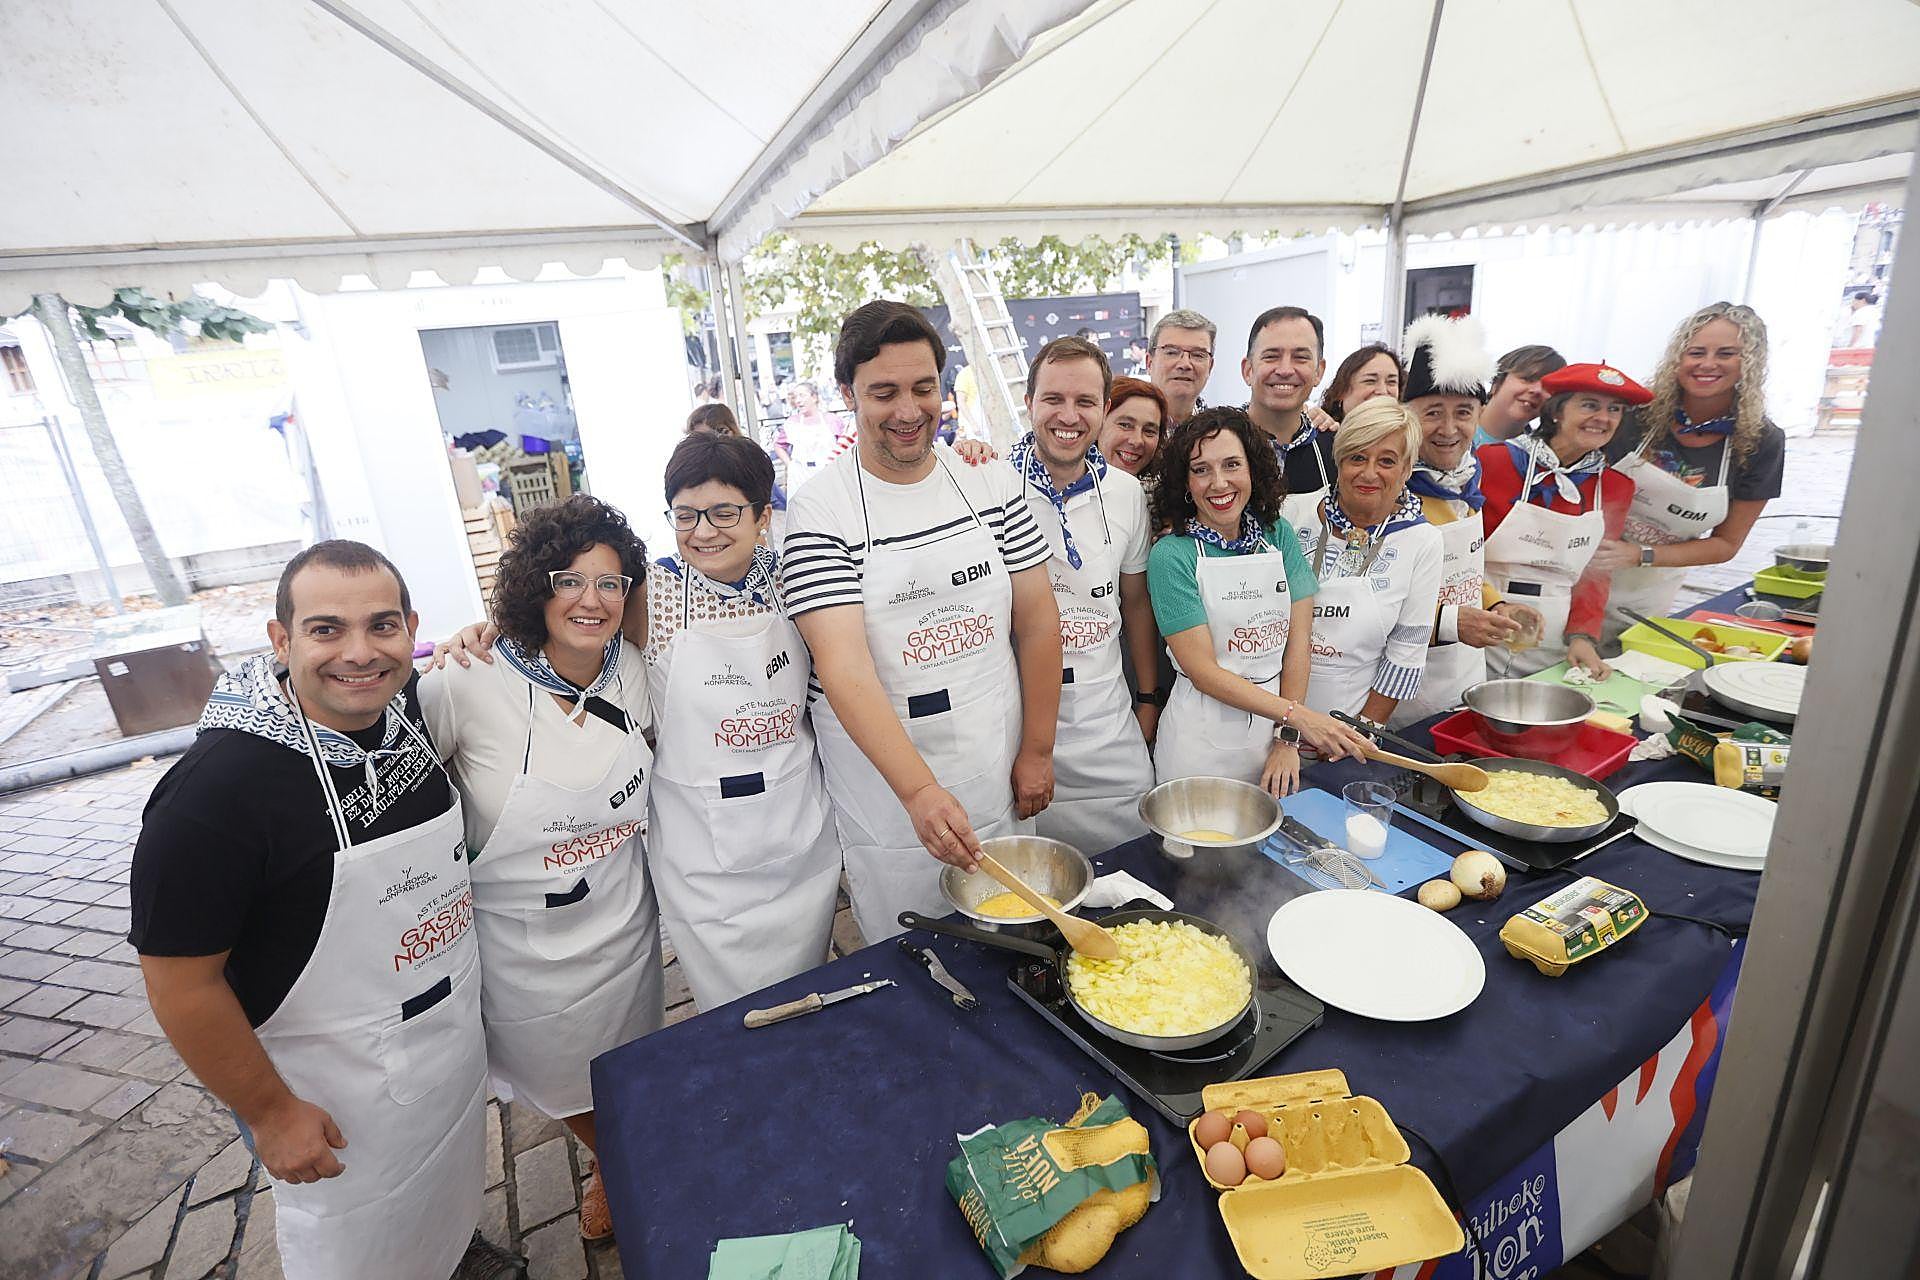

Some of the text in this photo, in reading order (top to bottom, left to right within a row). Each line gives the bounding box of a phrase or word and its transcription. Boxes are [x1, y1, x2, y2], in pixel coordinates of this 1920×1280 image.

[1680, 510, 1708, 521] BM
[1573, 536, 1590, 548] BM
[967, 561, 992, 582] BM
[918, 604, 975, 626] ASTE NAGUSIA
[1076, 607, 1109, 619] NAGUSIA
[1323, 605, 1351, 618] BM
[907, 614, 994, 648] GASTRO-
[902, 626, 995, 666] NOMIKOA
[771, 650, 790, 675] BM
[735, 701, 757, 715] ASTE
[626, 767, 644, 798] BM
[345, 804, 362, 822] EZ
[359, 783, 386, 809] DAO
[386, 871, 430, 895] BILBOKO
[416, 897, 439, 921] ASTE
[413, 949, 447, 971] CERTAMEN
[1355, 1224, 1376, 1234] zure
